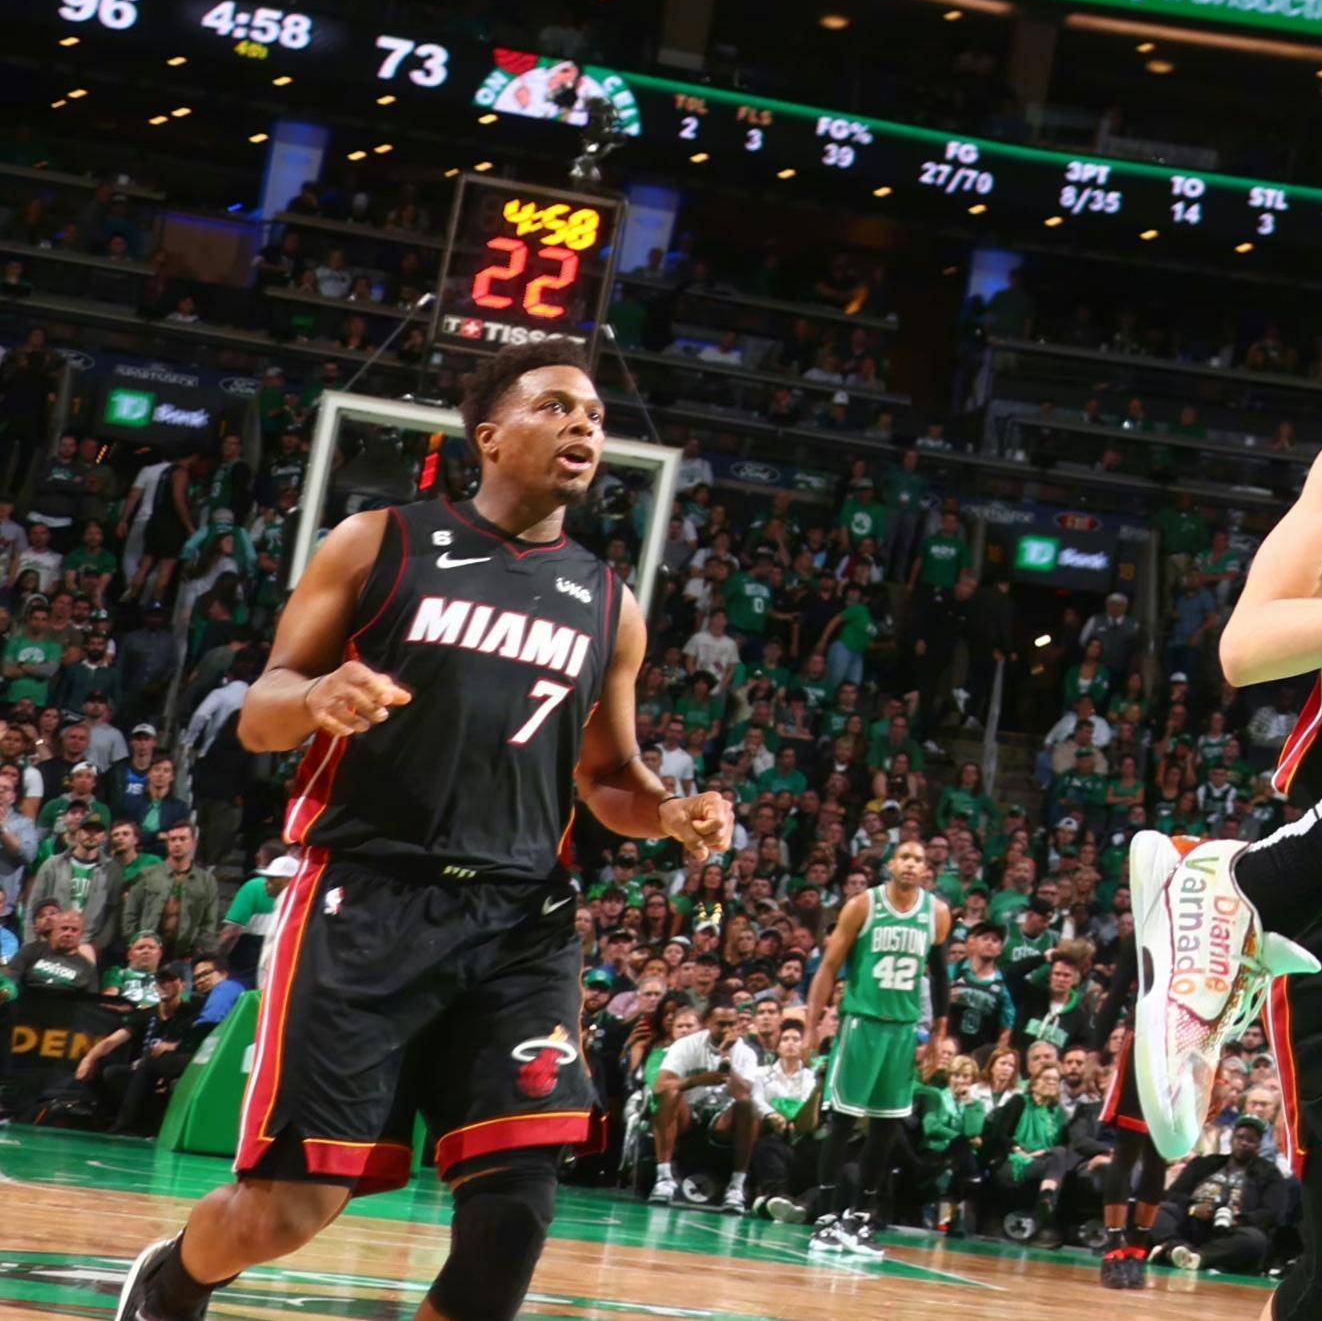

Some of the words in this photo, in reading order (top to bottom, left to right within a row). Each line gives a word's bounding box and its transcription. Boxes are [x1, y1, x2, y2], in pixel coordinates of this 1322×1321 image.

[202, 0, 312, 49] 4:58
[375, 35, 448, 86] 73
[679, 116, 699, 140] 2
[745, 128, 763, 151] 3
[822, 143, 855, 168] 39
[919, 161, 994, 194] 27/70
[1059, 185, 1122, 214] 8/35
[1171, 201, 1202, 225] 14
[1257, 213, 1275, 235] 3
[815, 117, 873, 145] FG%
[945, 141, 979, 164] FG
[1065, 161, 1111, 185] 3PT
[1170, 175, 1205, 198] TO
[1249, 186, 1288, 210] STL
[472, 237, 579, 319] 22
[484, 321, 586, 346] TISS
[432, 530, 453, 546] 6
[405, 596, 592, 678] MIAMI
[507, 678, 574, 745] 7
[872, 926, 927, 957] BOSTON
[1171, 856, 1220, 995] Varnado
[872, 955, 919, 991] 42
